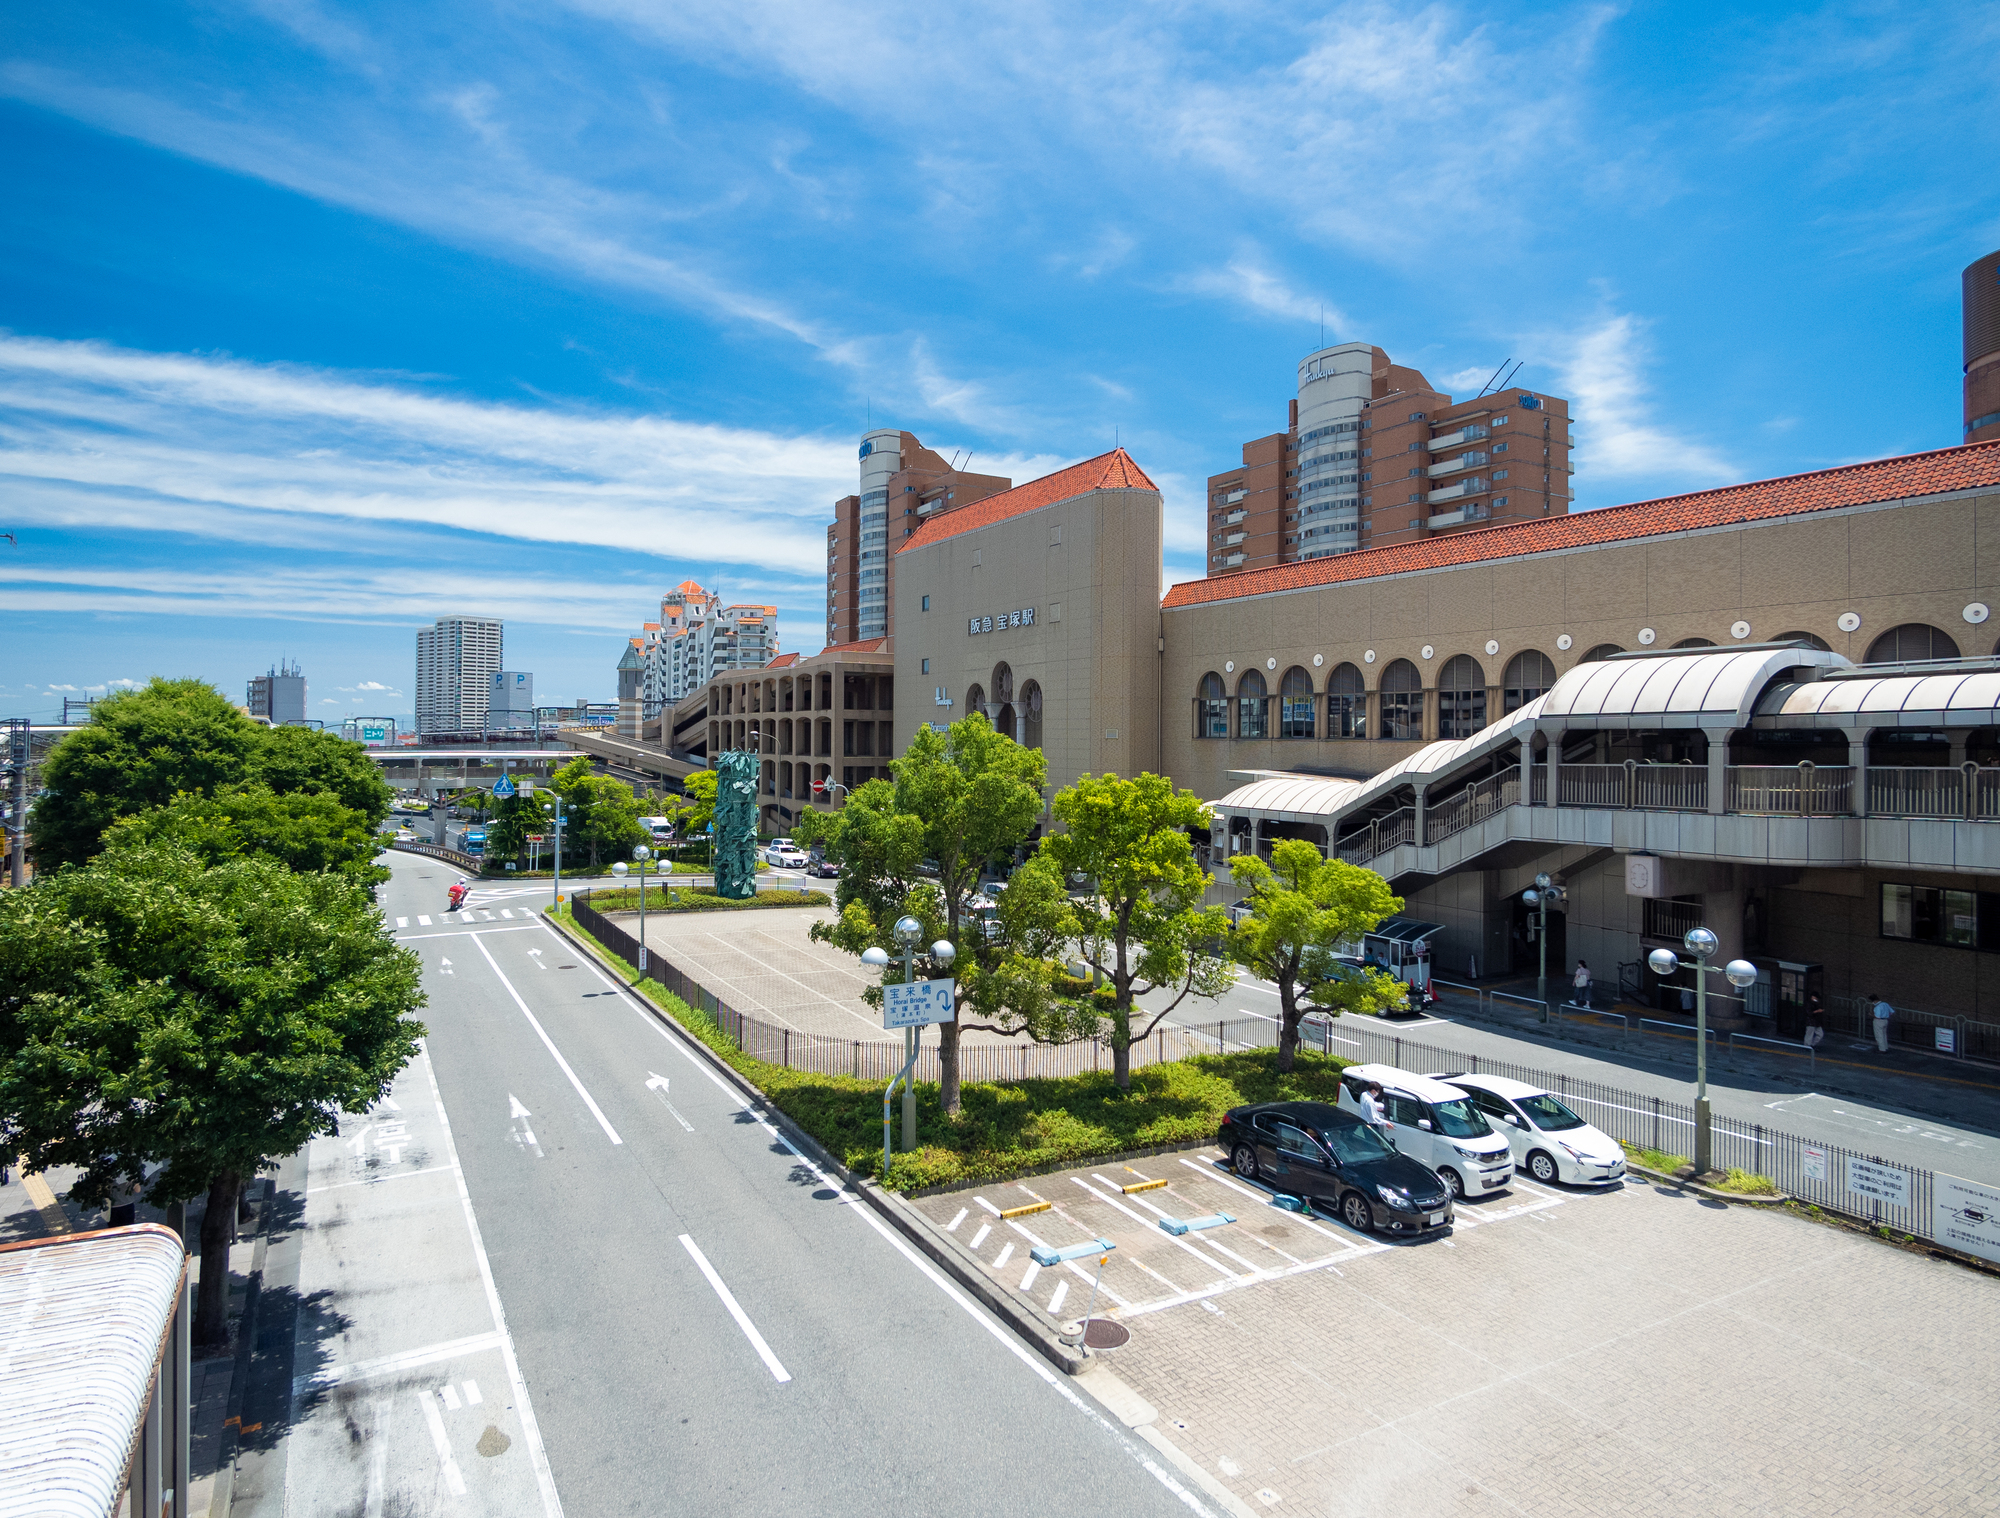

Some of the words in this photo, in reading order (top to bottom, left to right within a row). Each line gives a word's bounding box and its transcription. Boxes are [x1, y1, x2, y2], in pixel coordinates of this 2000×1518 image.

[970, 616, 992, 635] 阪急
[997, 608, 1034, 630] 宝塚駅
[366, 730, 384, 738] ニトリ
[890, 985, 932, 1000] 宝来橋
[910, 997, 928, 1005] Bridge
